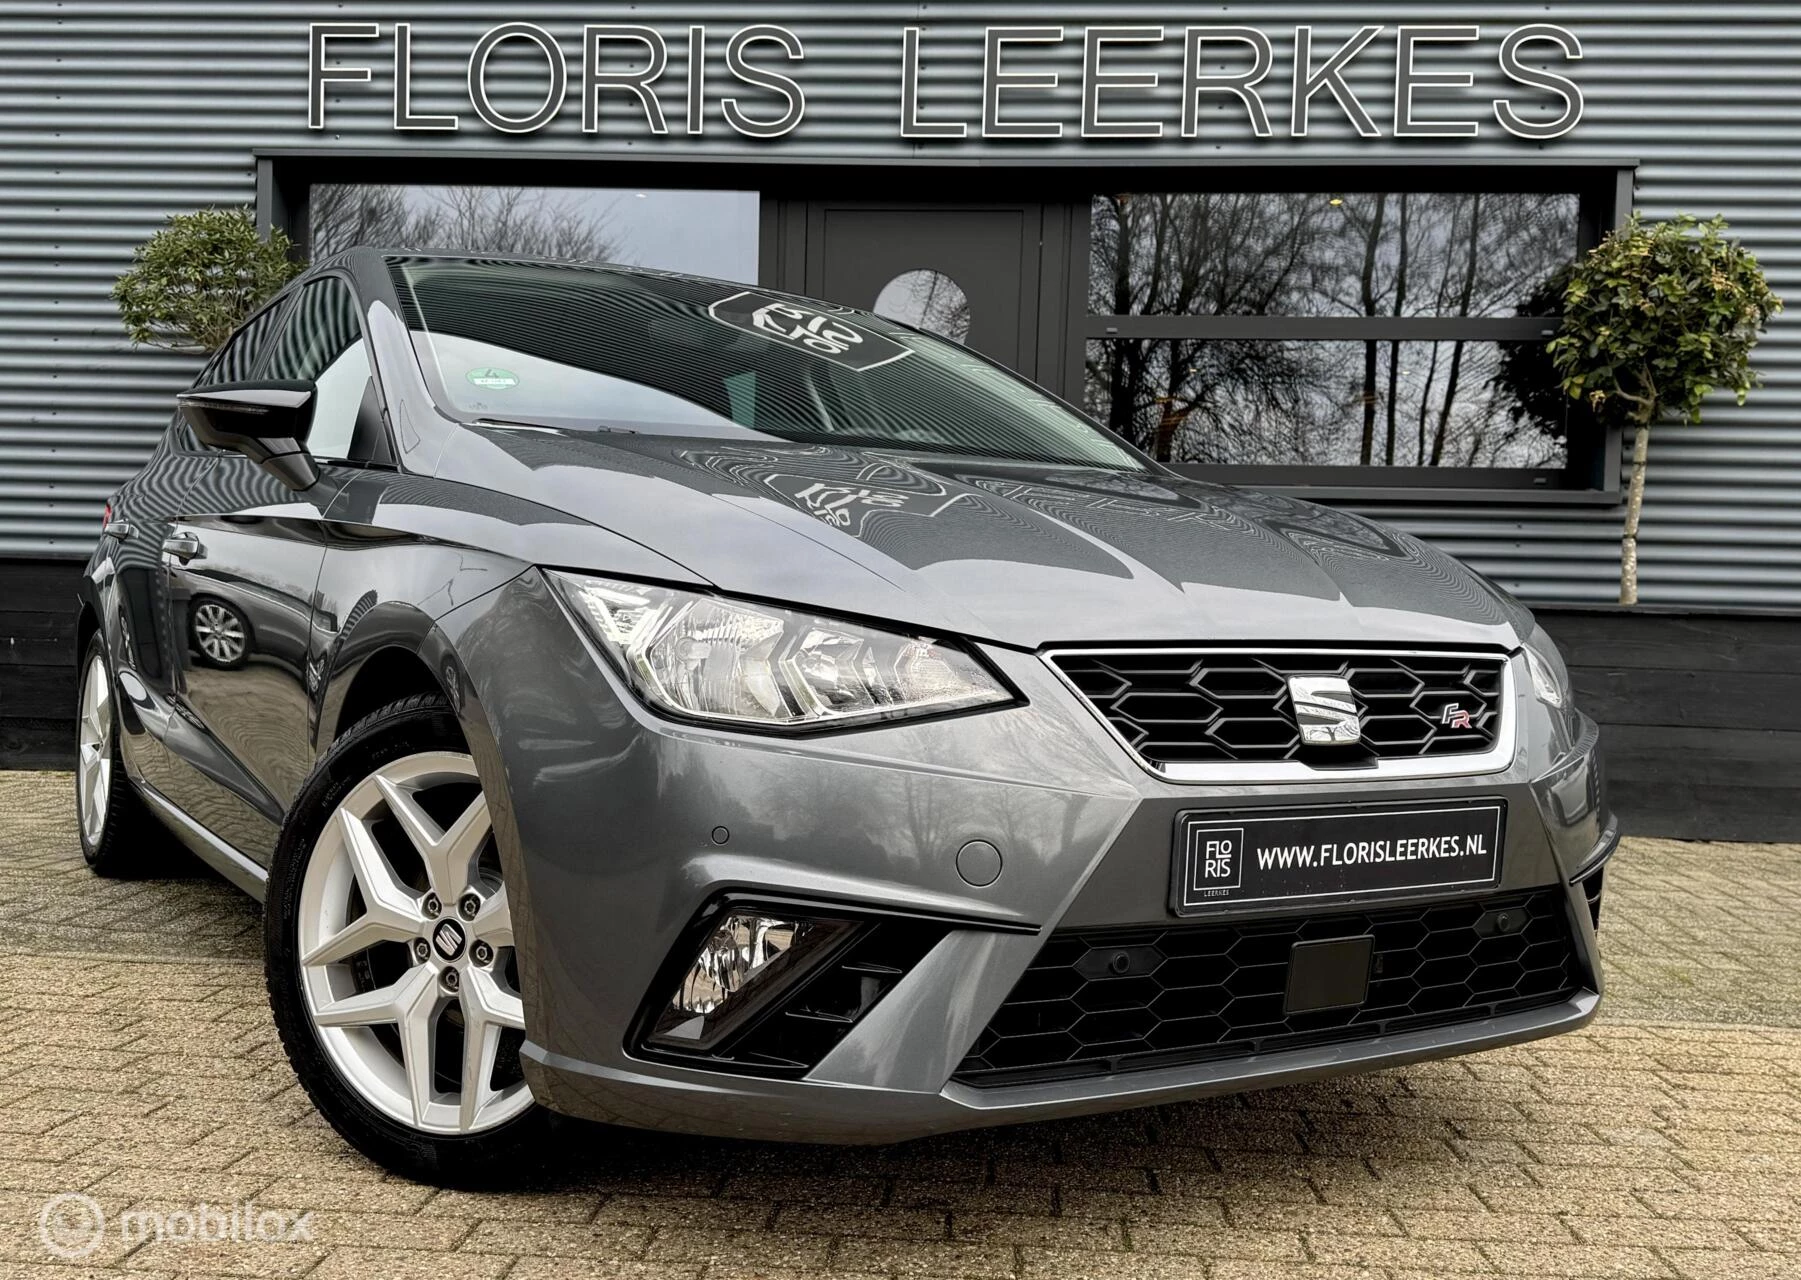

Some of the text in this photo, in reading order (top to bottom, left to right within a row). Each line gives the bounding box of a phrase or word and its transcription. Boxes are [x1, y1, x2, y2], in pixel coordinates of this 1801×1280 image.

[308, 21, 1585, 141] FLORIS LEERKES
[1441, 702, 1473, 729] FR
[1257, 834, 1487, 871] WWW.FLORISLEERKES.NL
[1203, 889, 1230, 897] LEERKES
